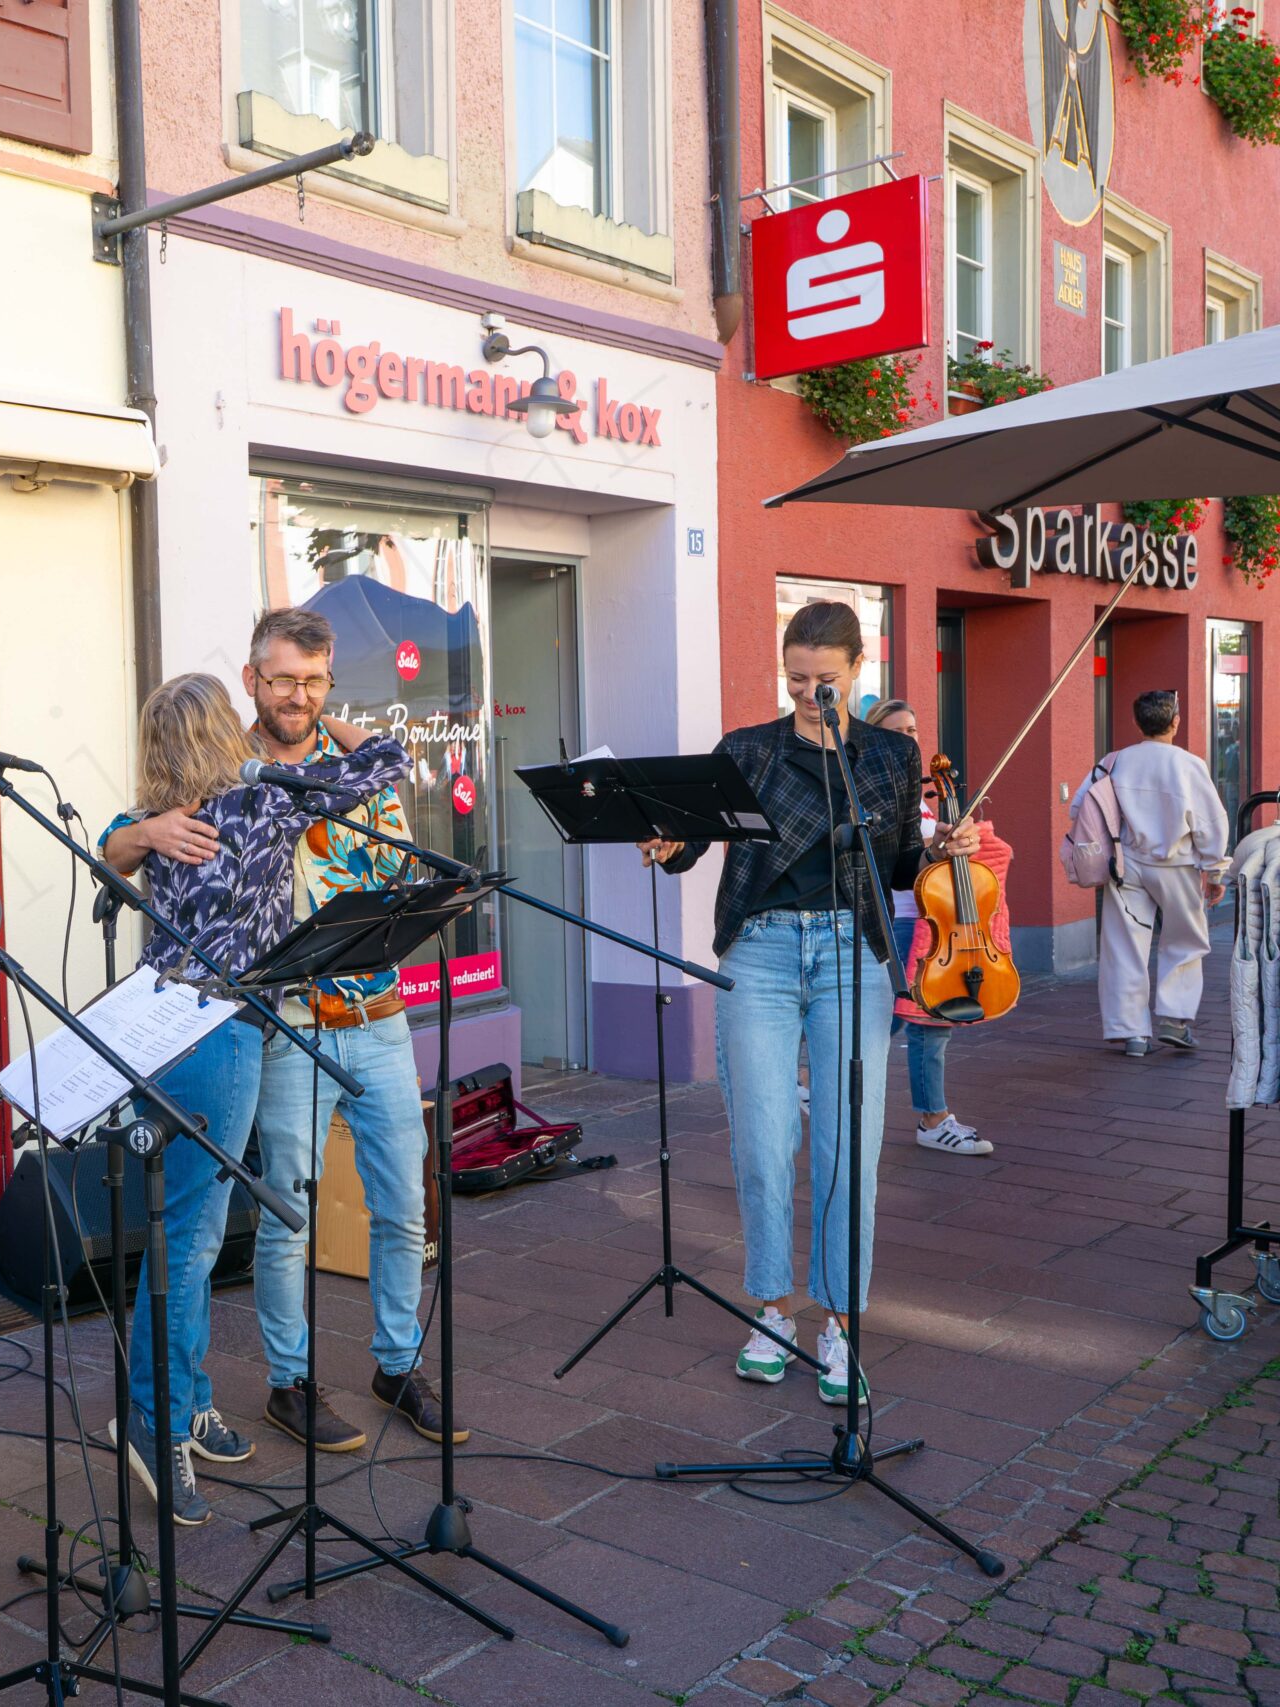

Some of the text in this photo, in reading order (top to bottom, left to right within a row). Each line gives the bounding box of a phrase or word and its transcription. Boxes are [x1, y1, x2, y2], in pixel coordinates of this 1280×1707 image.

[1060, 247, 1082, 273] HAUS
[1064, 268, 1079, 289] ZUM
[1058, 283, 1083, 310] ADLER
[598, 377, 661, 446] kox
[690, 532, 702, 552] 15
[990, 503, 1199, 591] Sparkasse
[397, 651, 419, 669] Sale
[494, 704, 503, 717] &
[506, 704, 526, 715] kox
[455, 783, 473, 806] Sale
[403, 981, 416, 995] bis
[418, 983, 428, 993] zu
[453, 965, 495, 986] reduziert!
[137, 1126, 146, 1154] K&M
